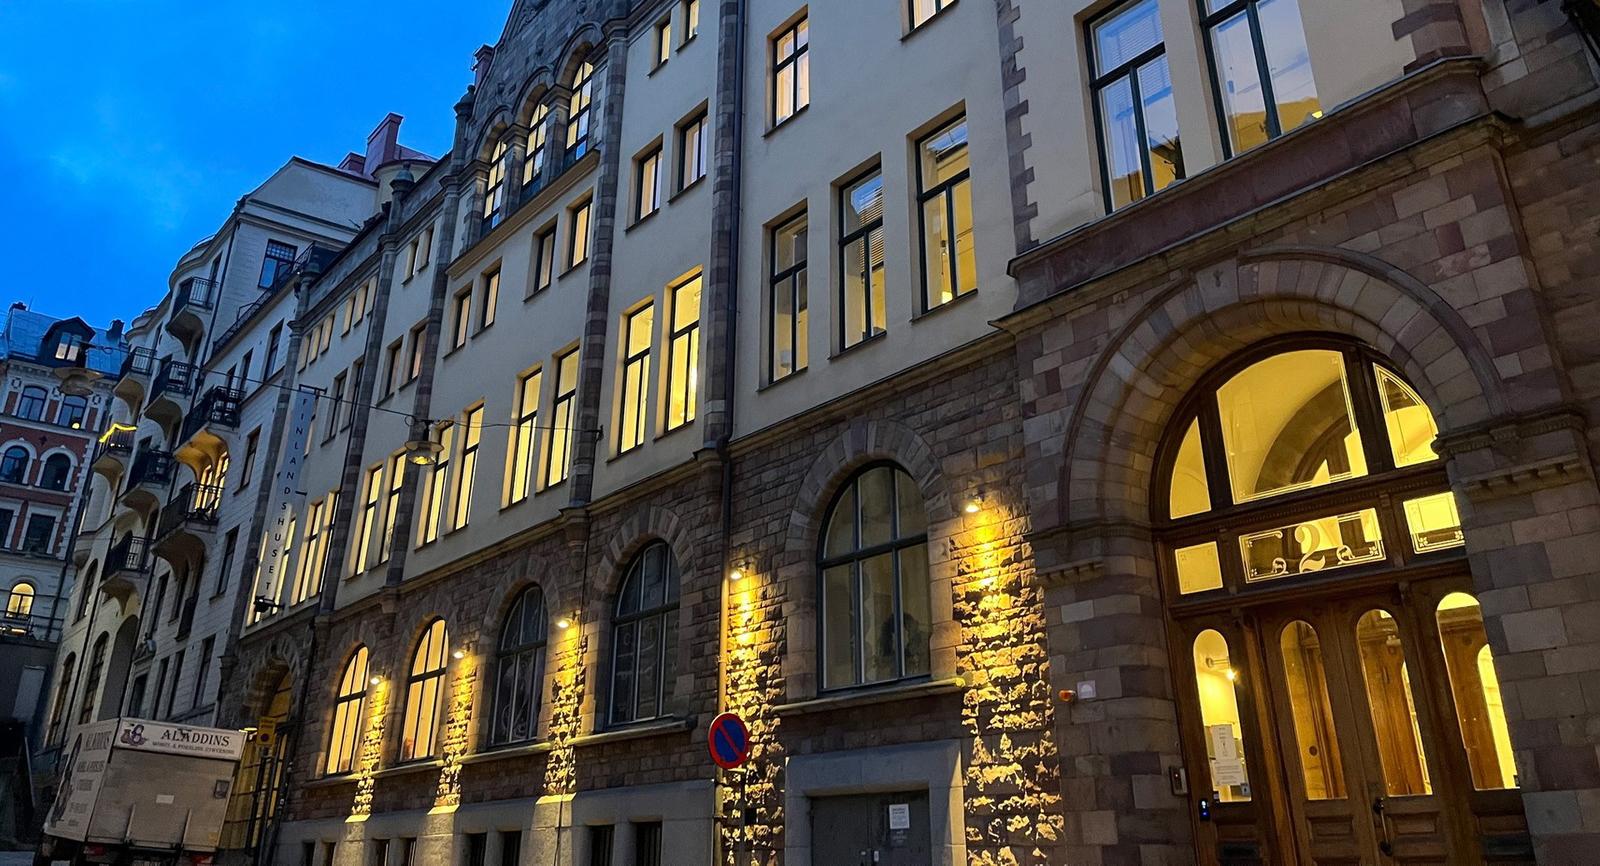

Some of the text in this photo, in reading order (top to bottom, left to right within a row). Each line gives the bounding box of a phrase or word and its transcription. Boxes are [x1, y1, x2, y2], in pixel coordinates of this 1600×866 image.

[265, 398, 308, 591] FINLANDSHUSET
[1294, 524, 1326, 574] 2
[161, 729, 230, 747] ALADDINS
